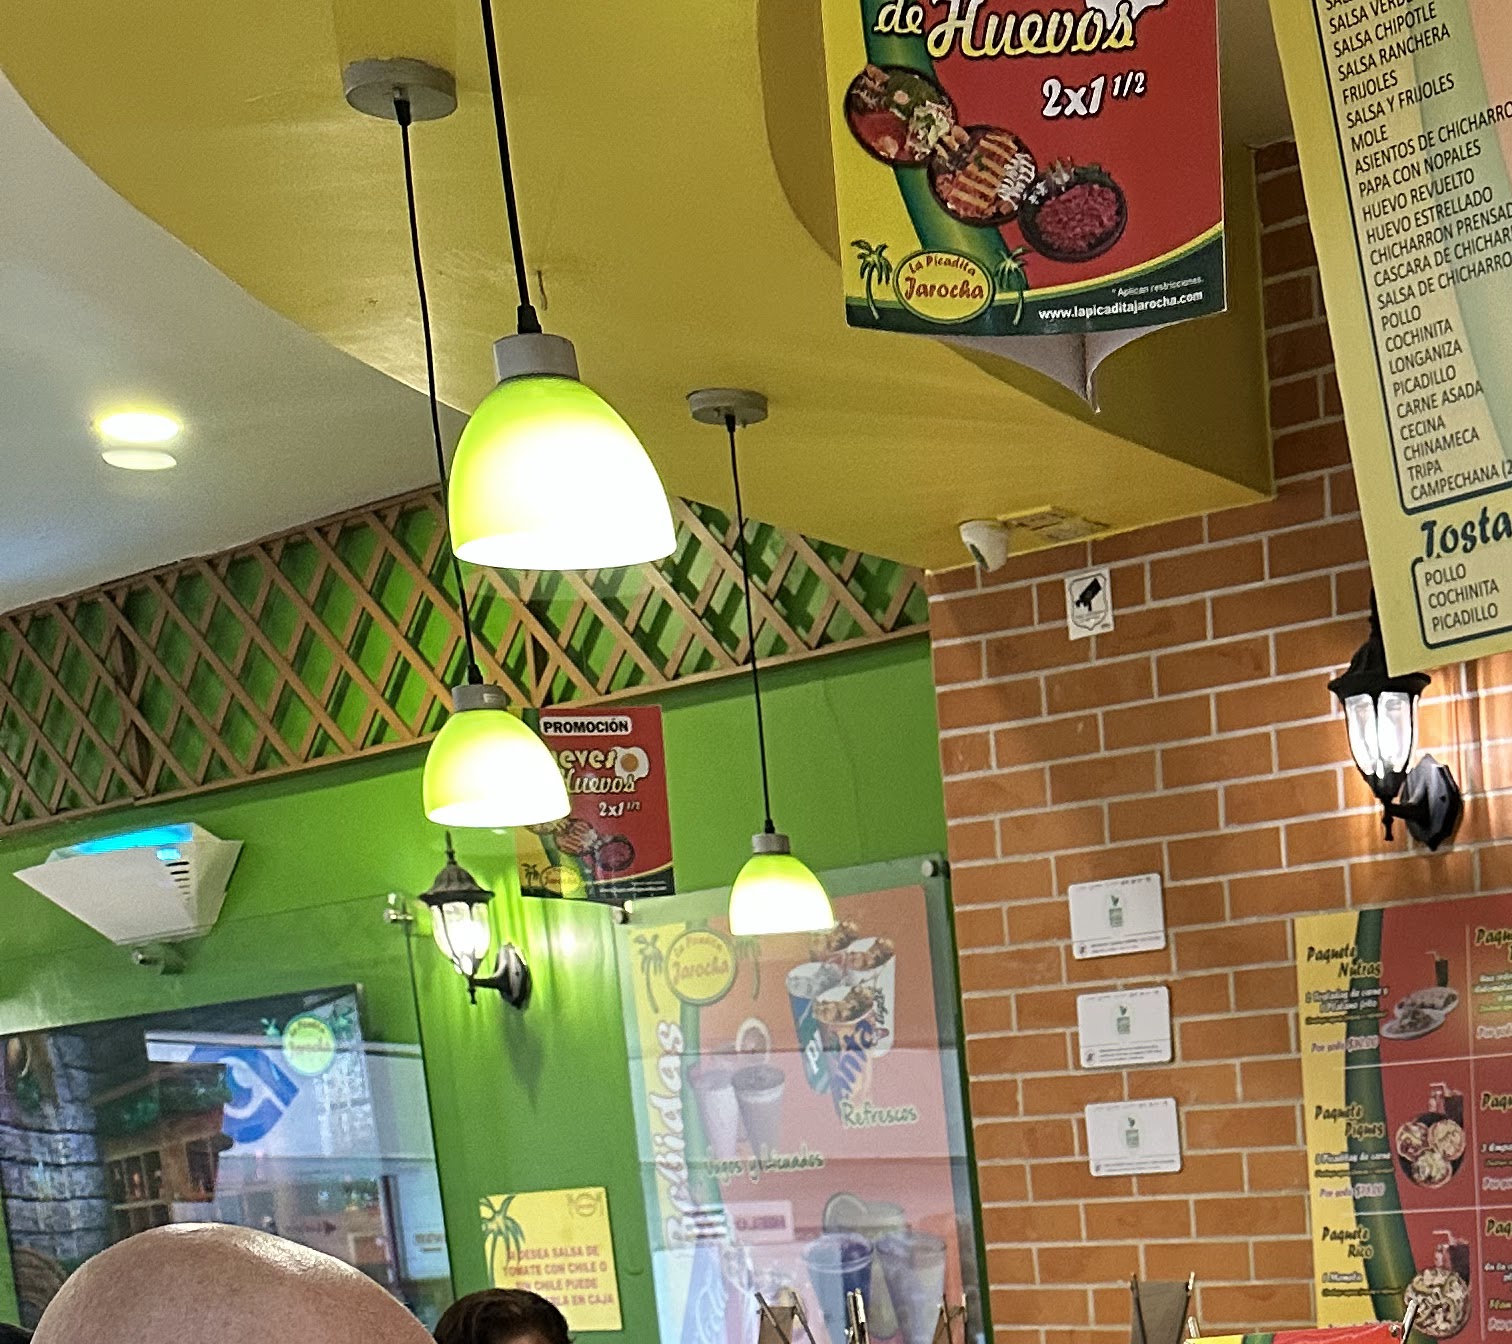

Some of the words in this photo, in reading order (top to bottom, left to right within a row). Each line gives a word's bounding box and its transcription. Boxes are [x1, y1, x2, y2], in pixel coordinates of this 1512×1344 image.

[873, 2, 924, 34] de
[926, 0, 1135, 57] Huevos
[1338, 53, 1378, 82] SALSA
[1379, 23, 1450, 66] RANCHERA
[1041, 75, 1107, 118] 2x1
[1342, 69, 1398, 105] FRIJOLES
[1355, 138, 1415, 175] ASIENTOS
[1418, 131, 1436, 151] DE
[909, 260, 924, 274] La
[925, 255, 976, 277] Picadita
[904, 277, 985, 301] Jarocha
[1038, 290, 1203, 321] www.lapicaditajarocha.com
[1428, 579, 1499, 609] COCHINITA
[543, 718, 629, 734] PROMOCIÓN
[1307, 944, 1357, 963] Paquete
[1315, 1104, 1364, 1121] Paquete
[1322, 1226, 1370, 1243] Paquete
